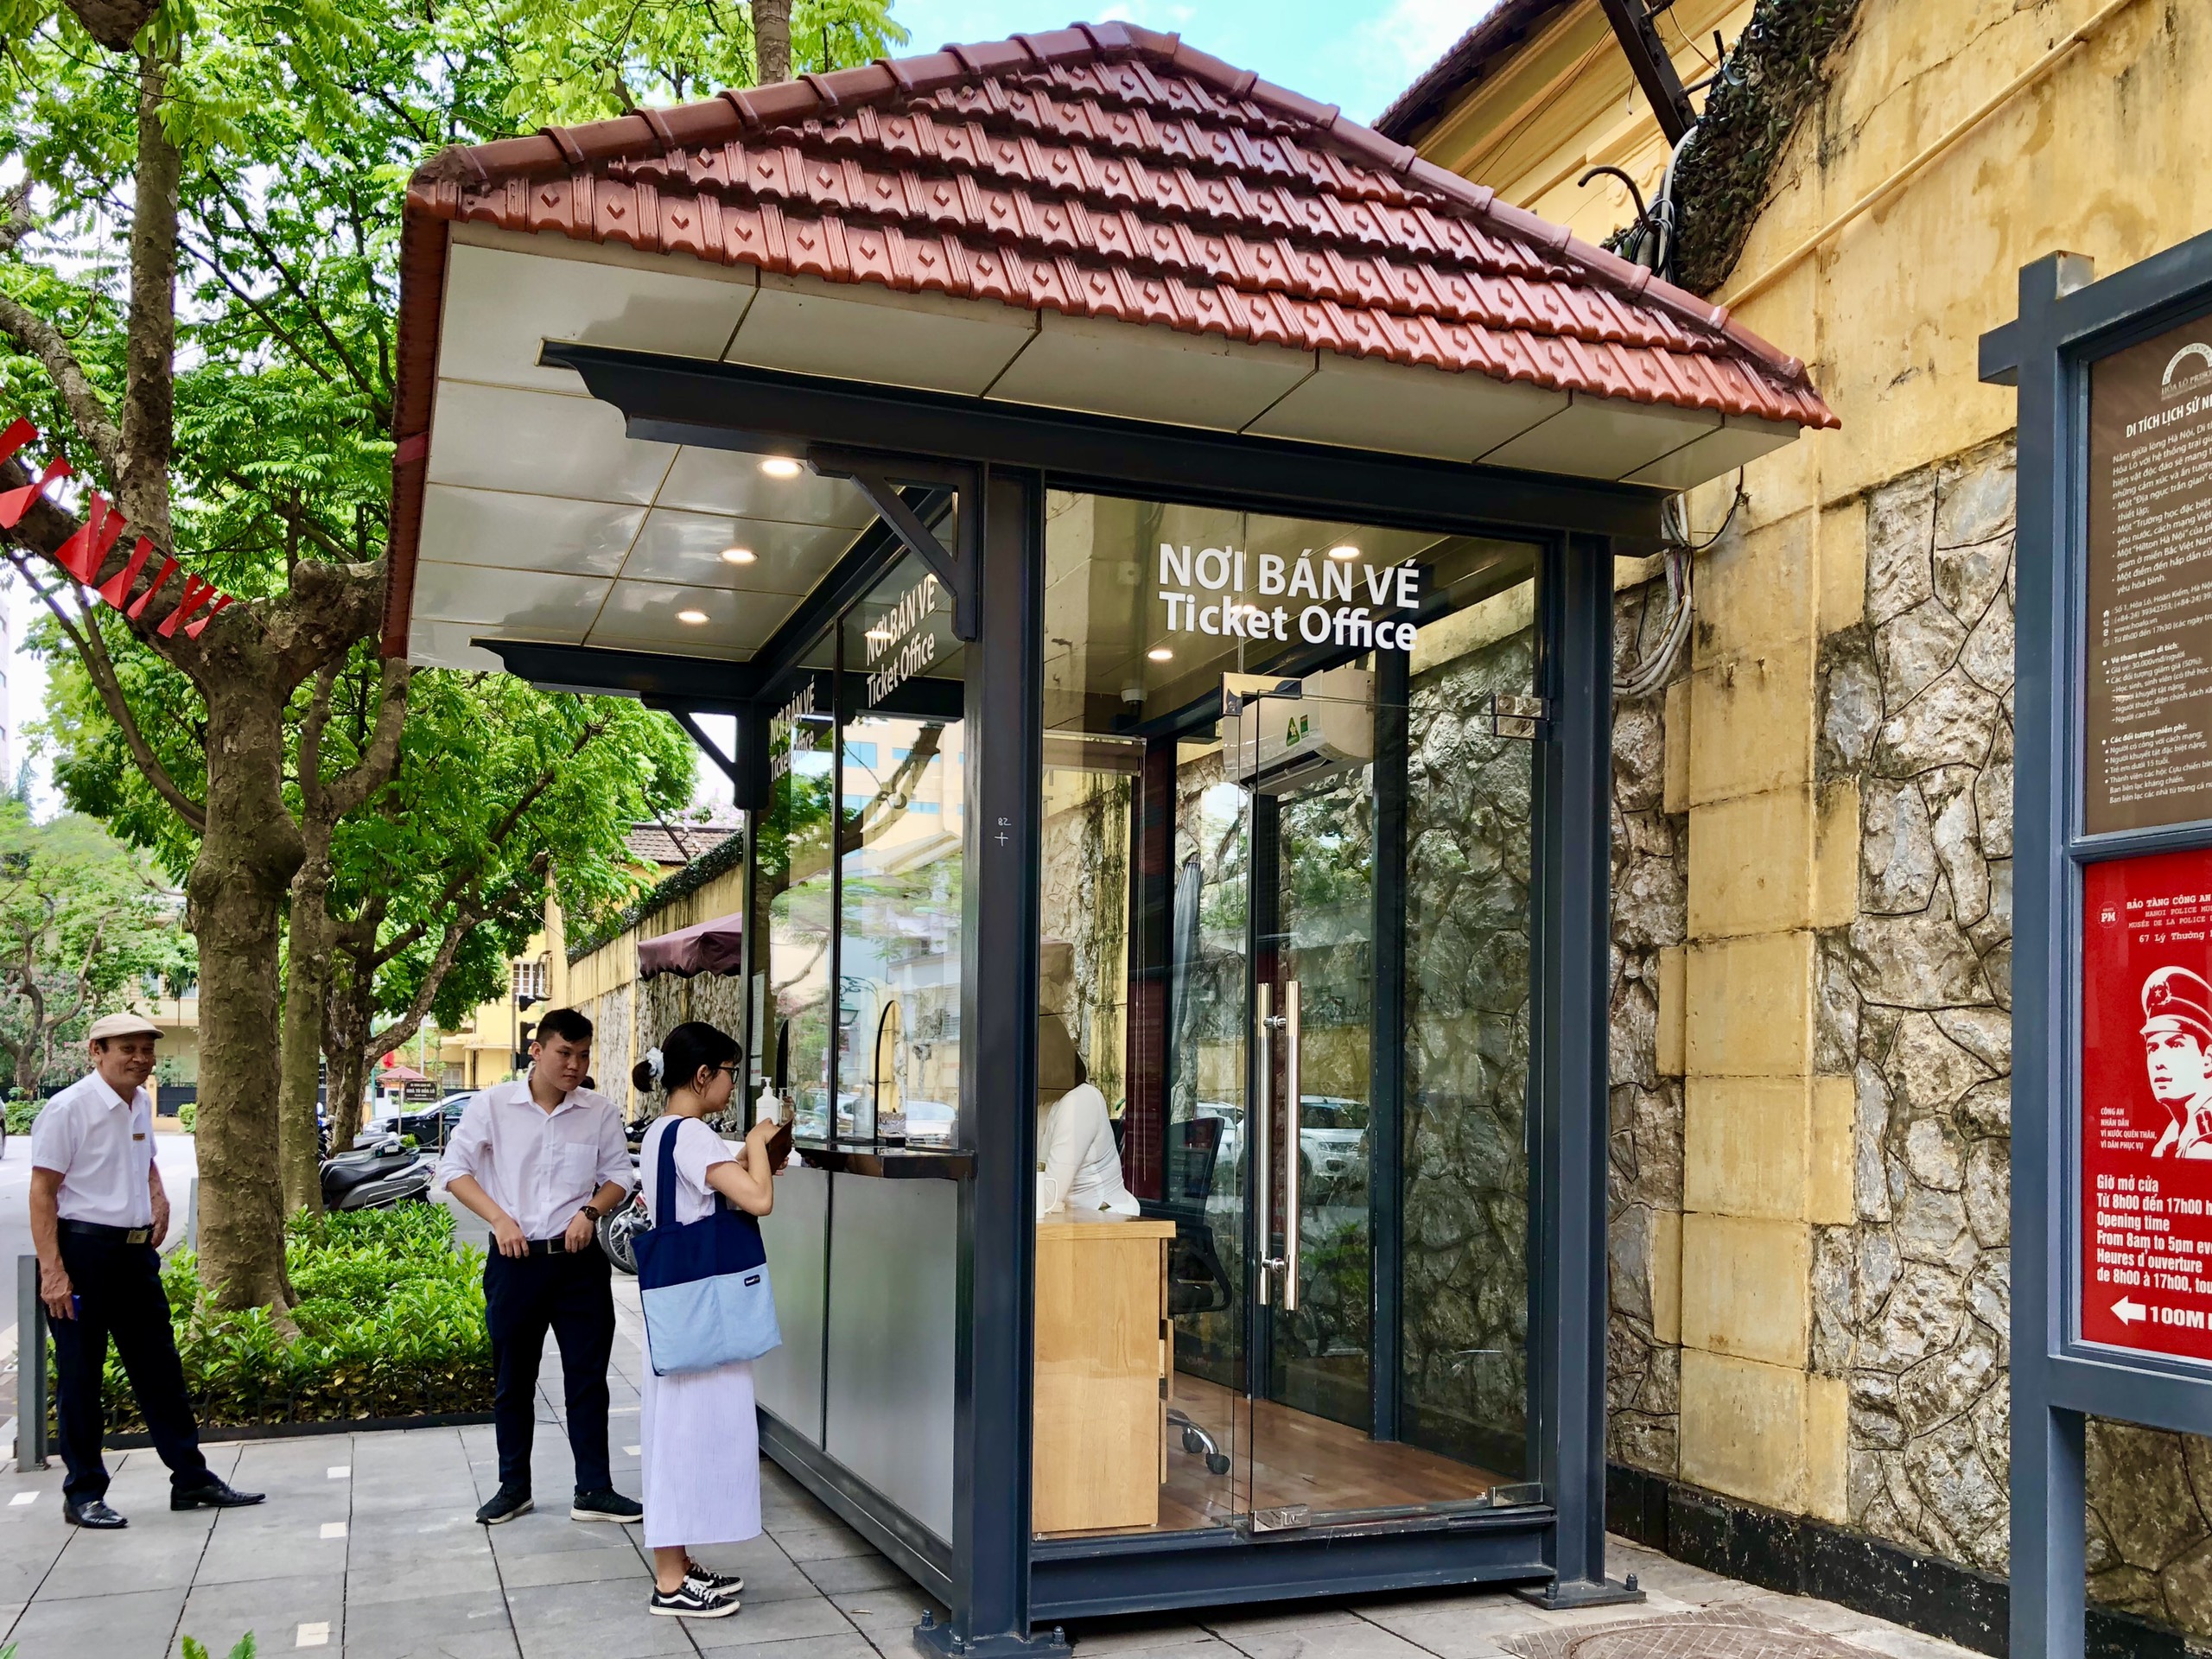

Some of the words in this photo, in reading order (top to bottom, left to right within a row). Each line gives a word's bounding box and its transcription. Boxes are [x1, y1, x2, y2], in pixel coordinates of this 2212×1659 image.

[2126, 423, 2136, 438] DI
[2139, 414, 2160, 433] TÍCH
[2162, 405, 2183, 426] LỊCH
[2186, 396, 2200, 416] SỬ
[1160, 543, 1243, 591] NƠI
[1259, 549, 1352, 601] BÁN
[1363, 559, 1420, 608] VÉ
[891, 590, 916, 646] BÁN
[1159, 591, 1288, 640] Ticket
[1300, 605, 1418, 651] Office
[867, 657, 898, 708] Ticket
[900, 632, 934, 681] Office
[771, 707, 785, 745] NƠI
[785, 691, 803, 734] BÁN
[804, 675, 815, 716] VÉ
[998, 817, 1011, 826] 82
[2126, 899, 2143, 909] BẢO
[2146, 897, 2170, 907] TÀNG
[2173, 894, 2196, 905] CÔNG
[2101, 912, 2116, 922] PM
[2128, 919, 2149, 928] MUSÉE
[2139, 934, 2149, 943] 67
[2155, 933, 2165, 943] Lý
[2171, 931, 2204, 940] Thường
[2101, 1107, 2115, 1116] CÔNG
[2118, 1118, 2129, 1127] DÂN
[2101, 1128, 2106, 1137] VÌ
[2107, 1128, 2123, 1138] NƯỚC
[2124, 1129, 2139, 1138] QUÊN
[2139, 1130, 2157, 1140] THÂN,
[2101, 1140, 2106, 1148] VÌ
[2107, 1140, 2119, 1148] DÂN
[2120, 1141, 2135, 1151] PHỤC
[2136, 1142, 2144, 1152] VỤ
[2097, 1174, 2114, 1190] Giờ
[2118, 1174, 2135, 1191] mở
[2138, 1175, 2158, 1192] cửa
[2097, 1192, 2110, 1208] Từ
[2113, 1194, 2139, 1210] 8h00
[2143, 1193, 2163, 1211] đến
[2167, 1198, 2202, 1214] 17h00
[2097, 1211, 2141, 1230] Opening
[2144, 1215, 2170, 1231] time
[2097, 1230, 2123, 1246] From
[2126, 1232, 2151, 1249] 8am
[2154, 1235, 2164, 1250] to
[2168, 1236, 2193, 1253] 5pm
[2097, 1248, 2134, 1266] Heures
[2097, 1267, 2110, 1282] de
[2113, 1268, 2139, 1285] 8h00
[2144, 1271, 2150, 1287] à
[2154, 1273, 2192, 1294] 17h00,
[2150, 1306, 2204, 1329] 100M
